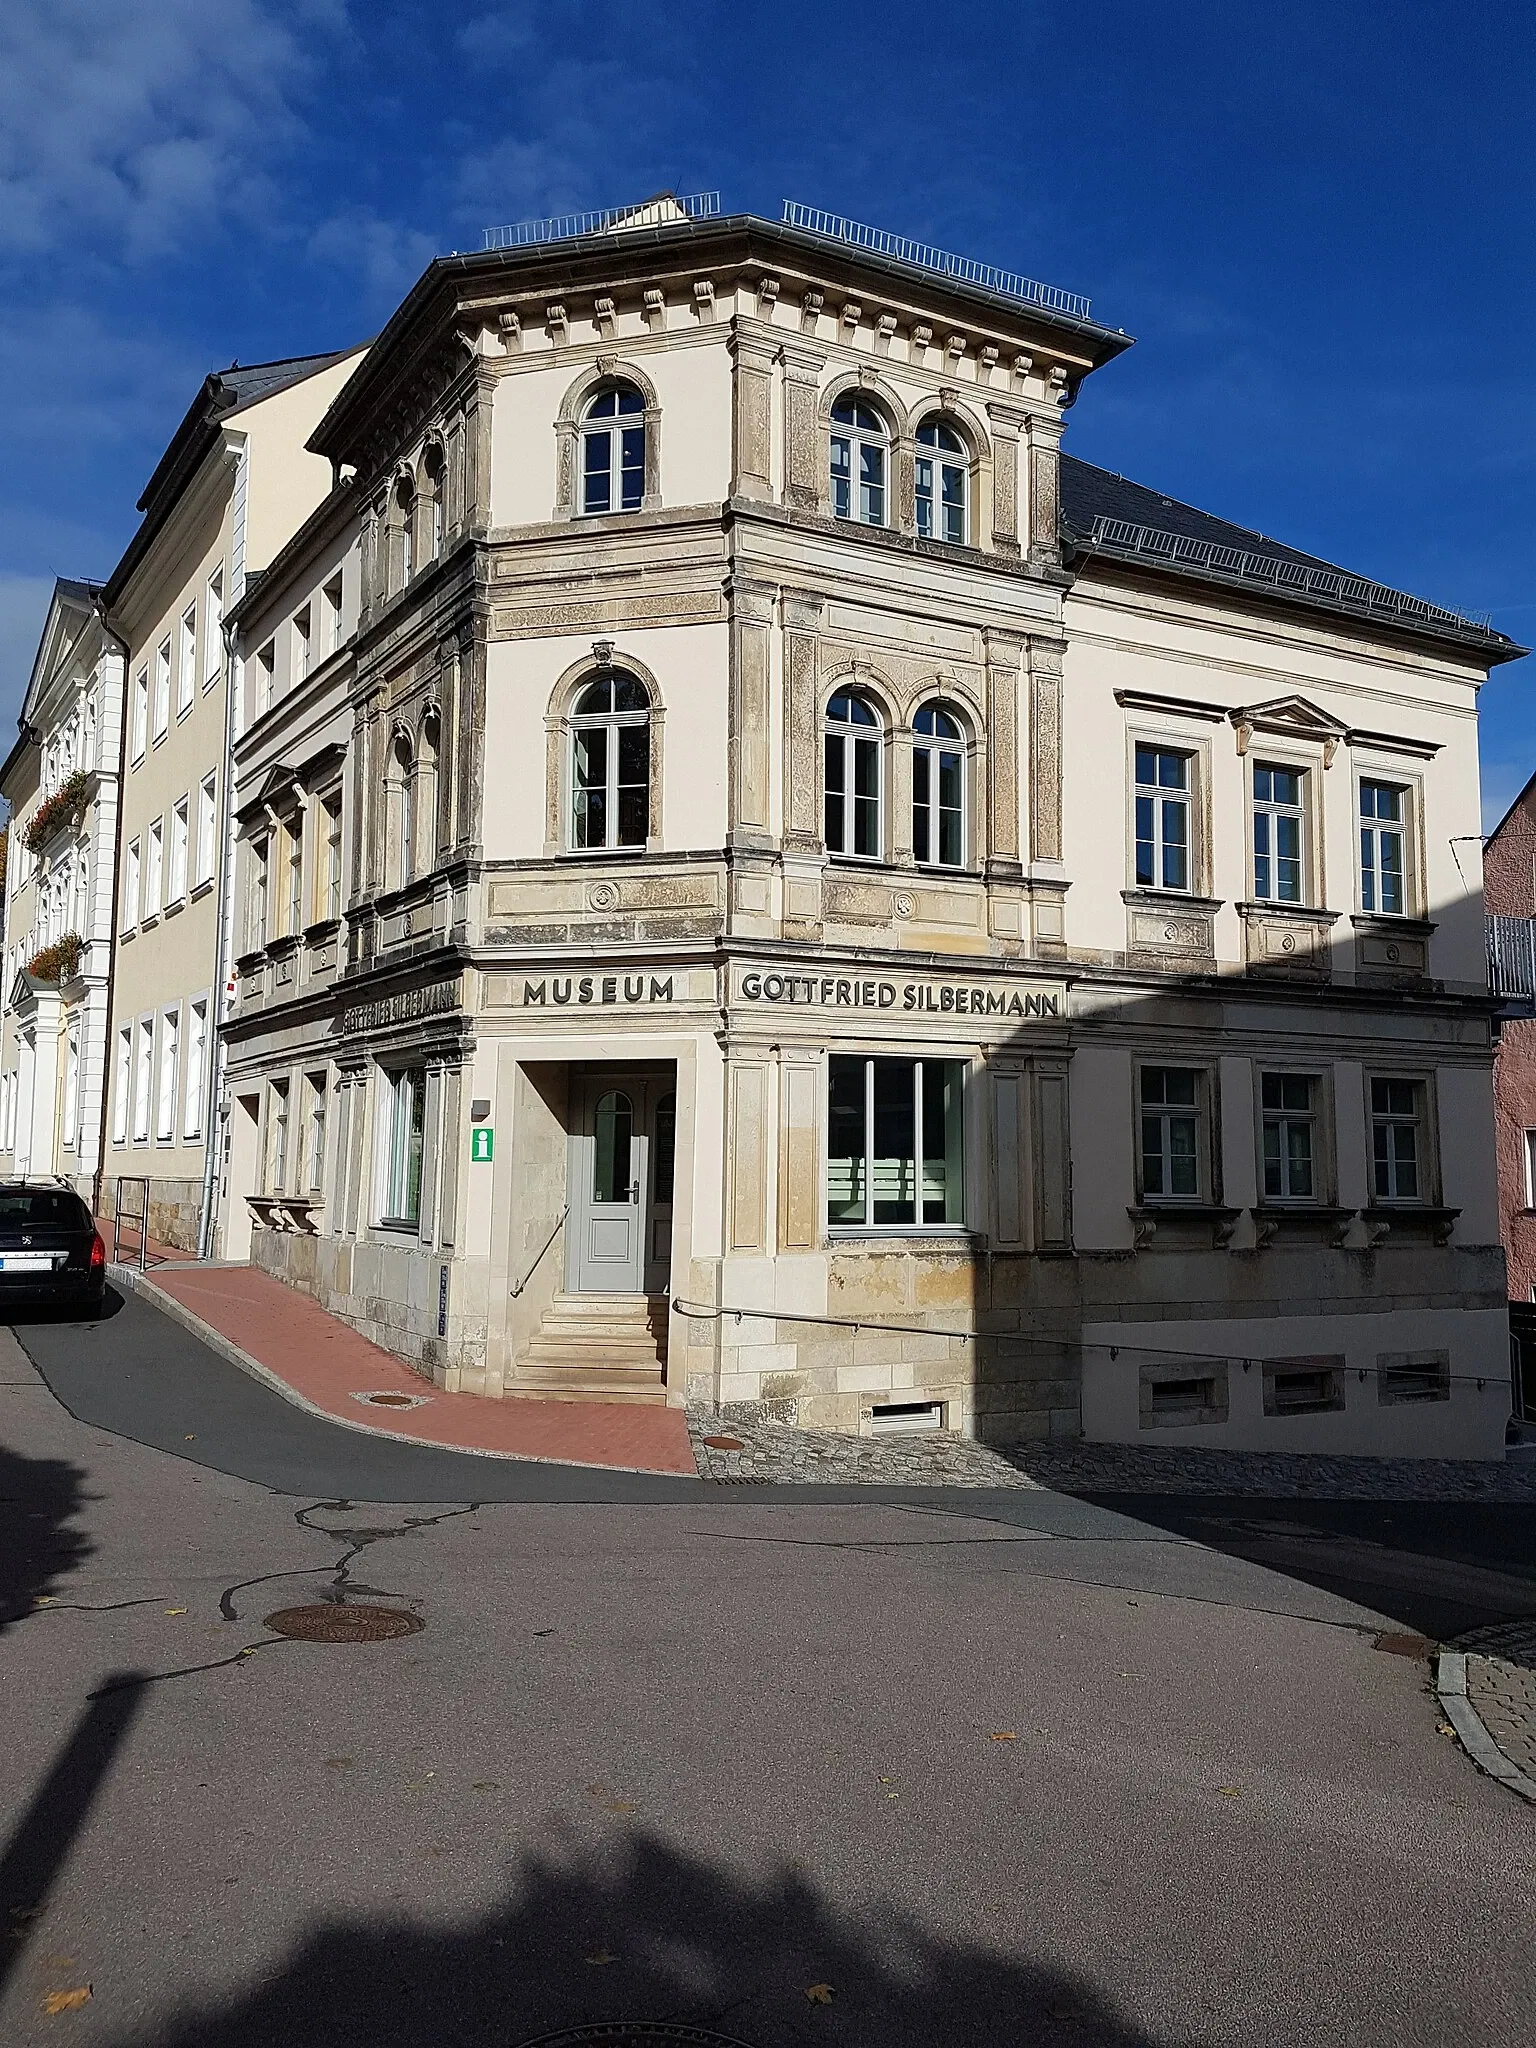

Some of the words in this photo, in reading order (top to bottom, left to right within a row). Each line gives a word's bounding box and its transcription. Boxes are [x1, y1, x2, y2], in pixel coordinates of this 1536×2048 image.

[524, 975, 673, 1006] MUSEUM
[742, 973, 897, 1008] GOTTFRIED
[903, 984, 1059, 1018] SILBERMANN
